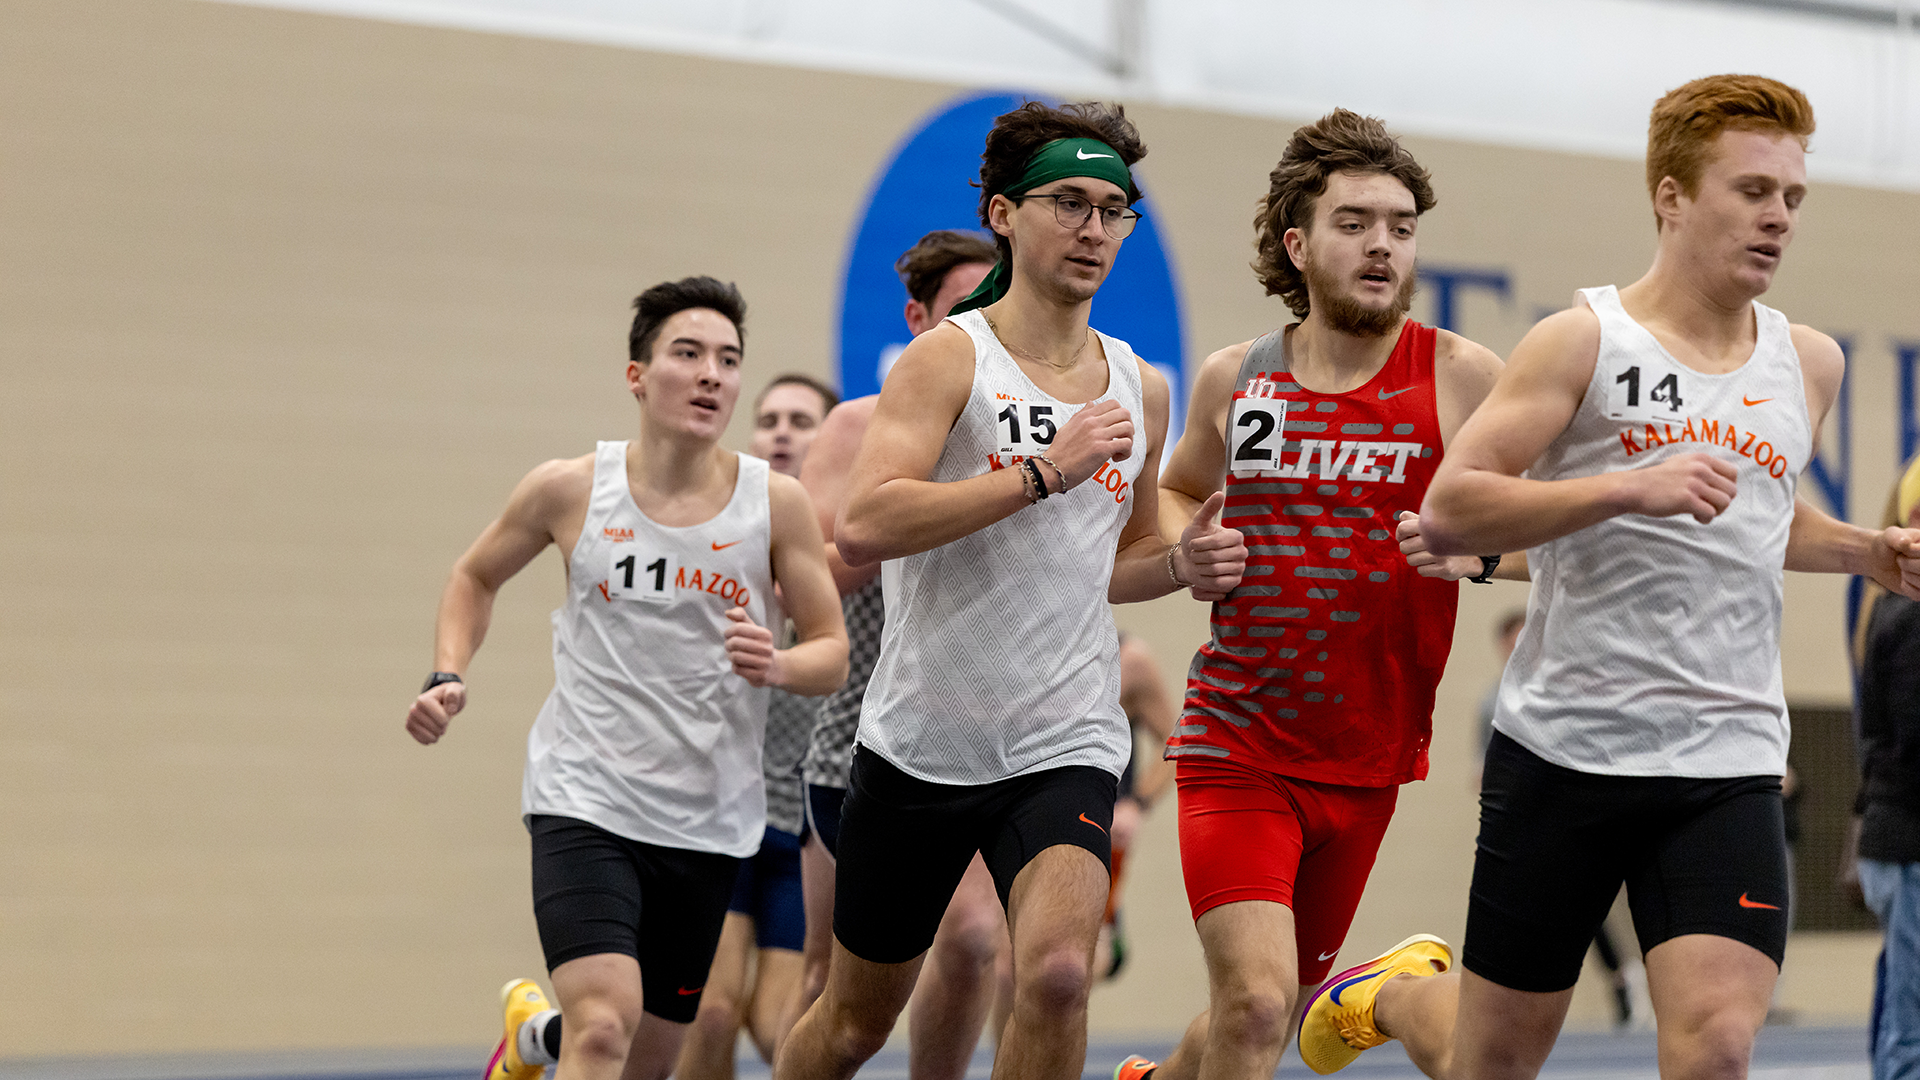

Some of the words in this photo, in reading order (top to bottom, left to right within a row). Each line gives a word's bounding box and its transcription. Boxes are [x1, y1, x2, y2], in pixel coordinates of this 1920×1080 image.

[1616, 366, 1683, 412] 14
[998, 404, 1057, 445] 15
[1234, 410, 1276, 461] 2
[1620, 417, 1787, 479] KALAMAZOO
[615, 555, 667, 591] 11
